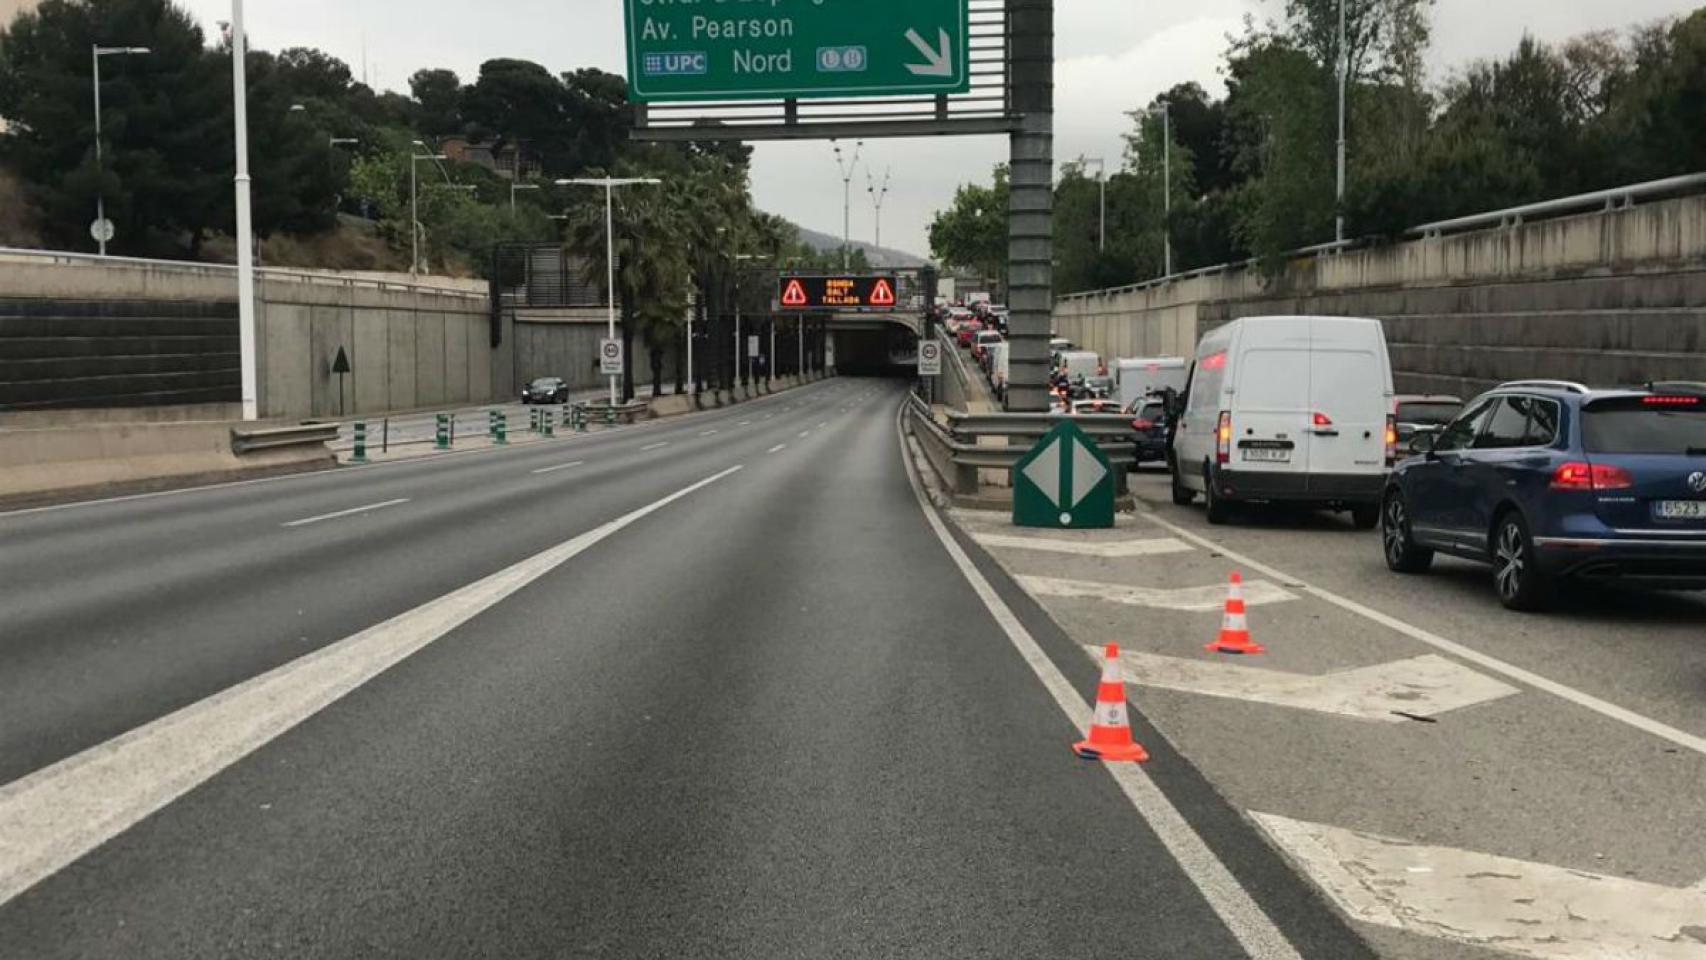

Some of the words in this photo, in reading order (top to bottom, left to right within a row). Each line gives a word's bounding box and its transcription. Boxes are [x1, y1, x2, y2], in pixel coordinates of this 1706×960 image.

[642, 17, 678, 40] Av.
[692, 15, 793, 39] Pearson
[664, 54, 705, 72] UPC
[733, 48, 792, 74] Nord
